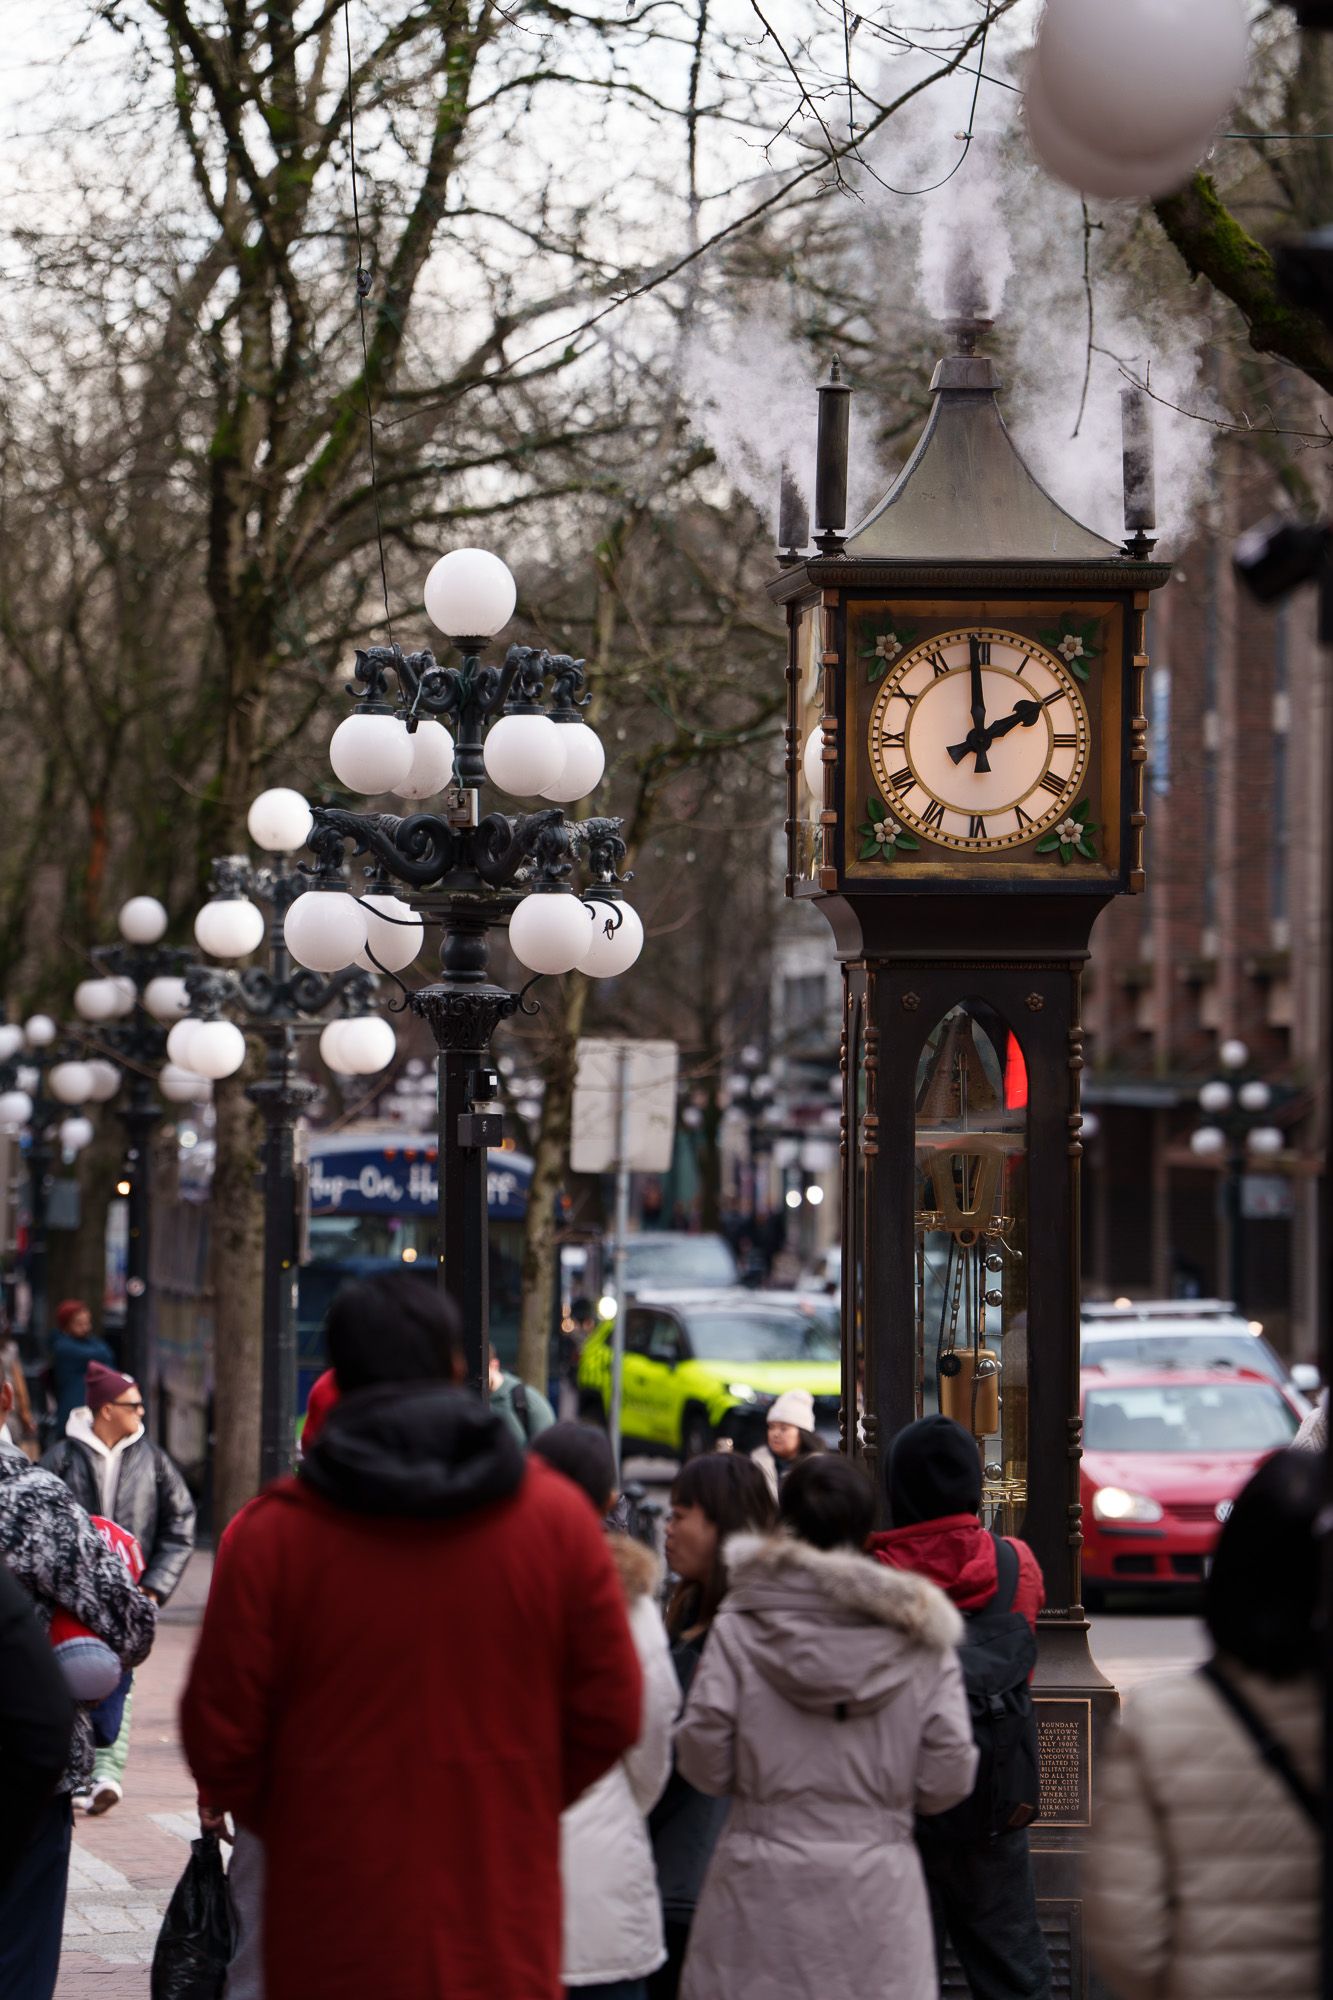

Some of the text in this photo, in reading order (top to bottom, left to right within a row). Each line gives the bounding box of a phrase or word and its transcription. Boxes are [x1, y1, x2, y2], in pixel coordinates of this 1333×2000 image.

[925, 651, 950, 678] XI
[1016, 654, 1031, 676] I
[891, 685, 919, 707] X
[1042, 688, 1066, 707] II
[882, 731, 905, 748] IX
[1053, 733, 1077, 748] III
[888, 766, 917, 799] VIII
[1039, 770, 1068, 798] IIII
[921, 799, 946, 830] VII
[1014, 804, 1034, 829] V
[969, 815, 988, 838] VI
